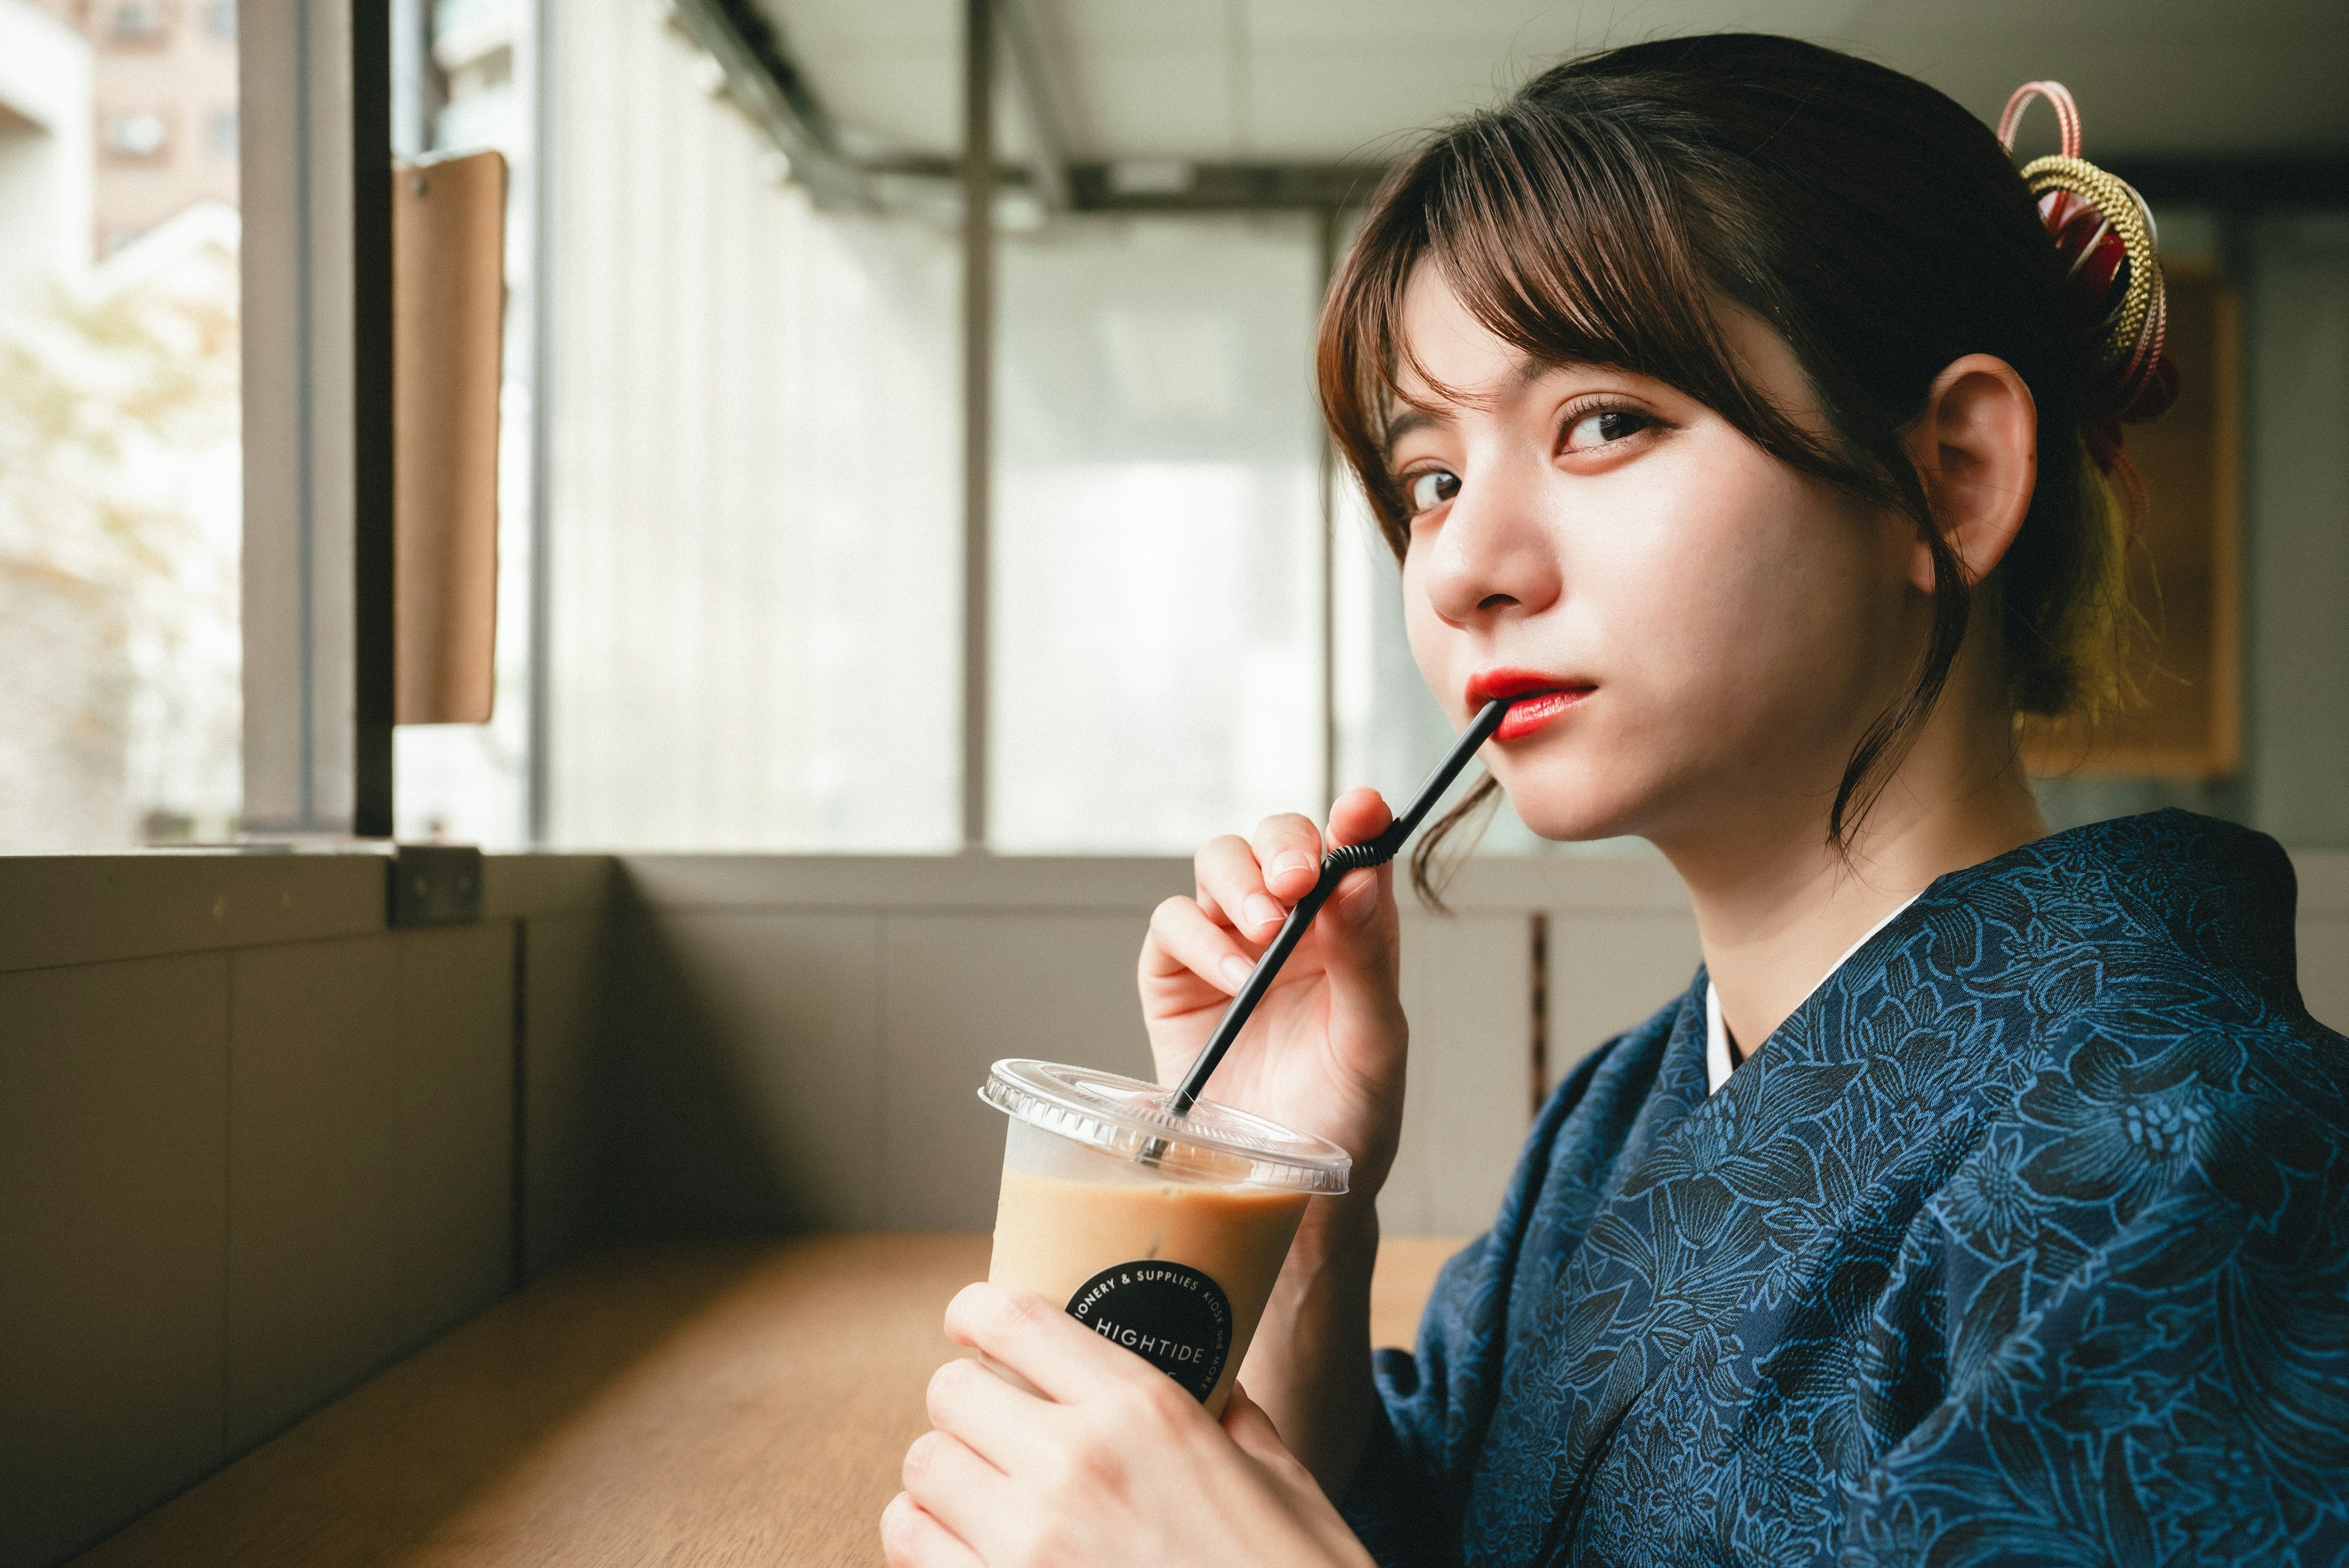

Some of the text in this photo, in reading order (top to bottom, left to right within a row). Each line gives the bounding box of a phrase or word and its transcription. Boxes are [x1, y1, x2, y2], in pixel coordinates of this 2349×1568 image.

[1121, 1273, 1131, 1284] &
[1137, 1270, 1198, 1291] SUPPLIES
[1203, 1291, 1224, 1325] KIOSK
[1095, 1317, 1204, 1364] HIGHTIDE
[1201, 1356, 1220, 1390] MORE
